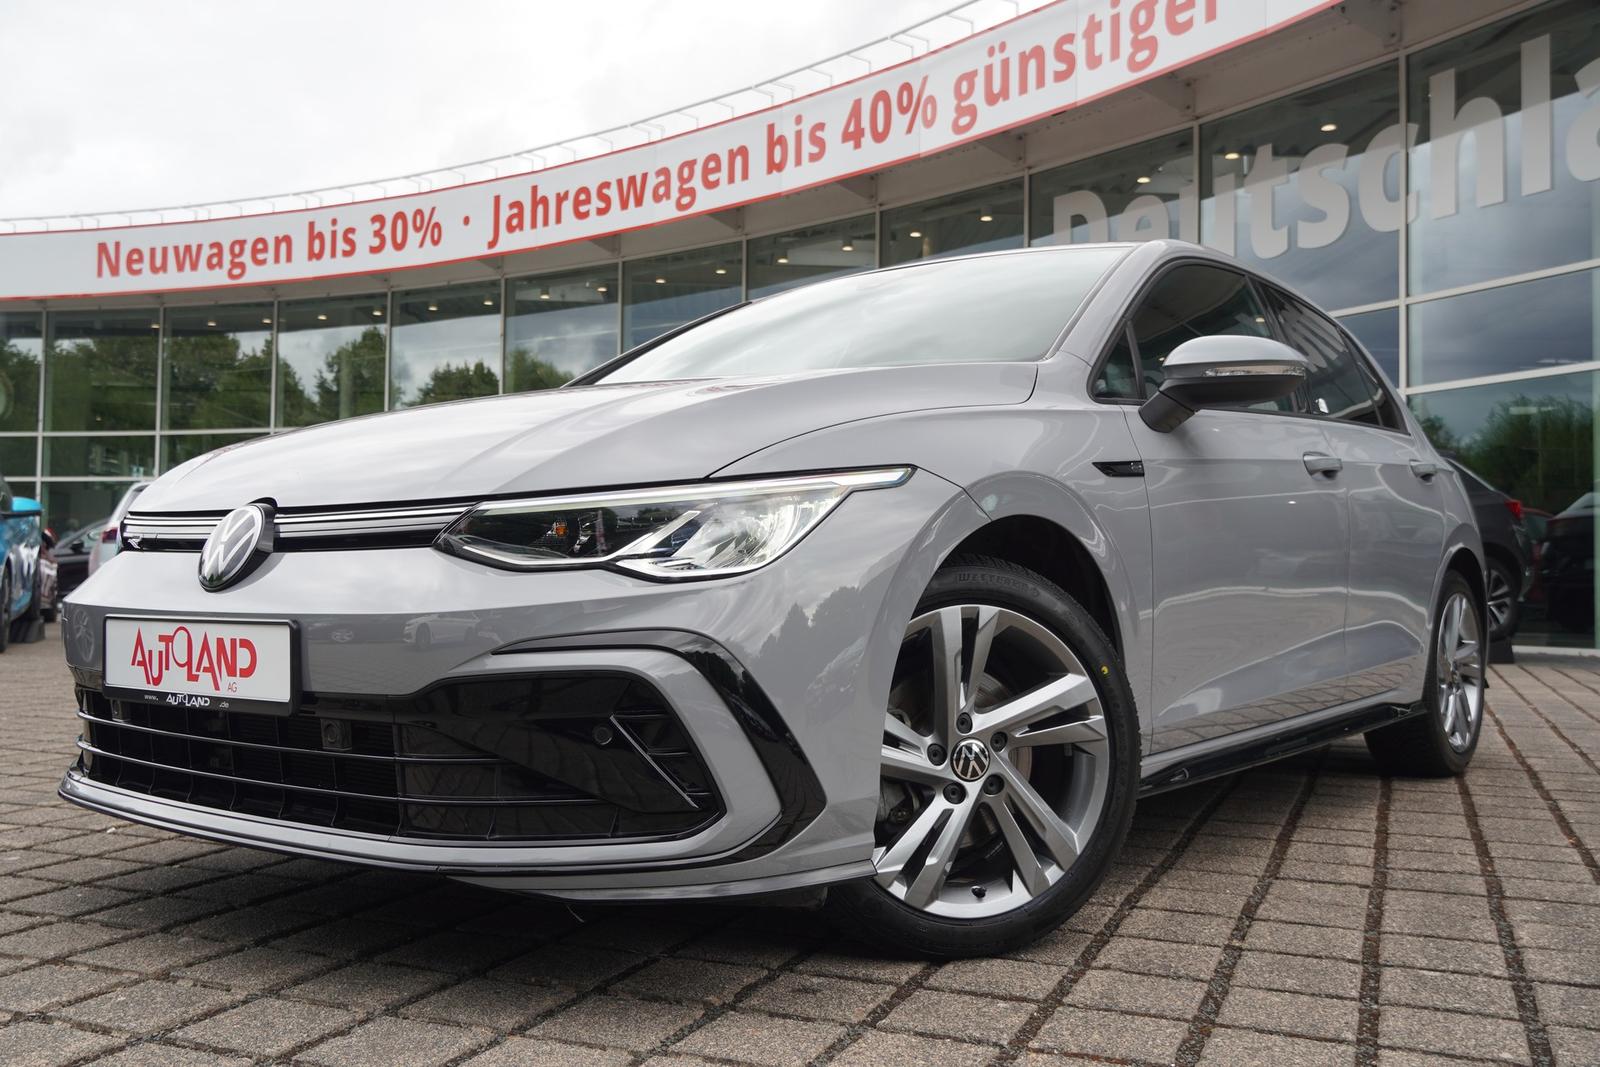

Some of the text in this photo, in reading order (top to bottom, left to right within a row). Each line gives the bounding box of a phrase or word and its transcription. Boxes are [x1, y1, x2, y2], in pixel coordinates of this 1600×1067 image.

[96, 234, 294, 281] Neuwagen
[306, 217, 358, 262] bis
[367, 207, 443, 255] 30%
[486, 145, 750, 250] Jahreswagen
[766, 115, 827, 175] bis
[841, 77, 937, 151] 40%
[227, 682, 238, 693] AG
